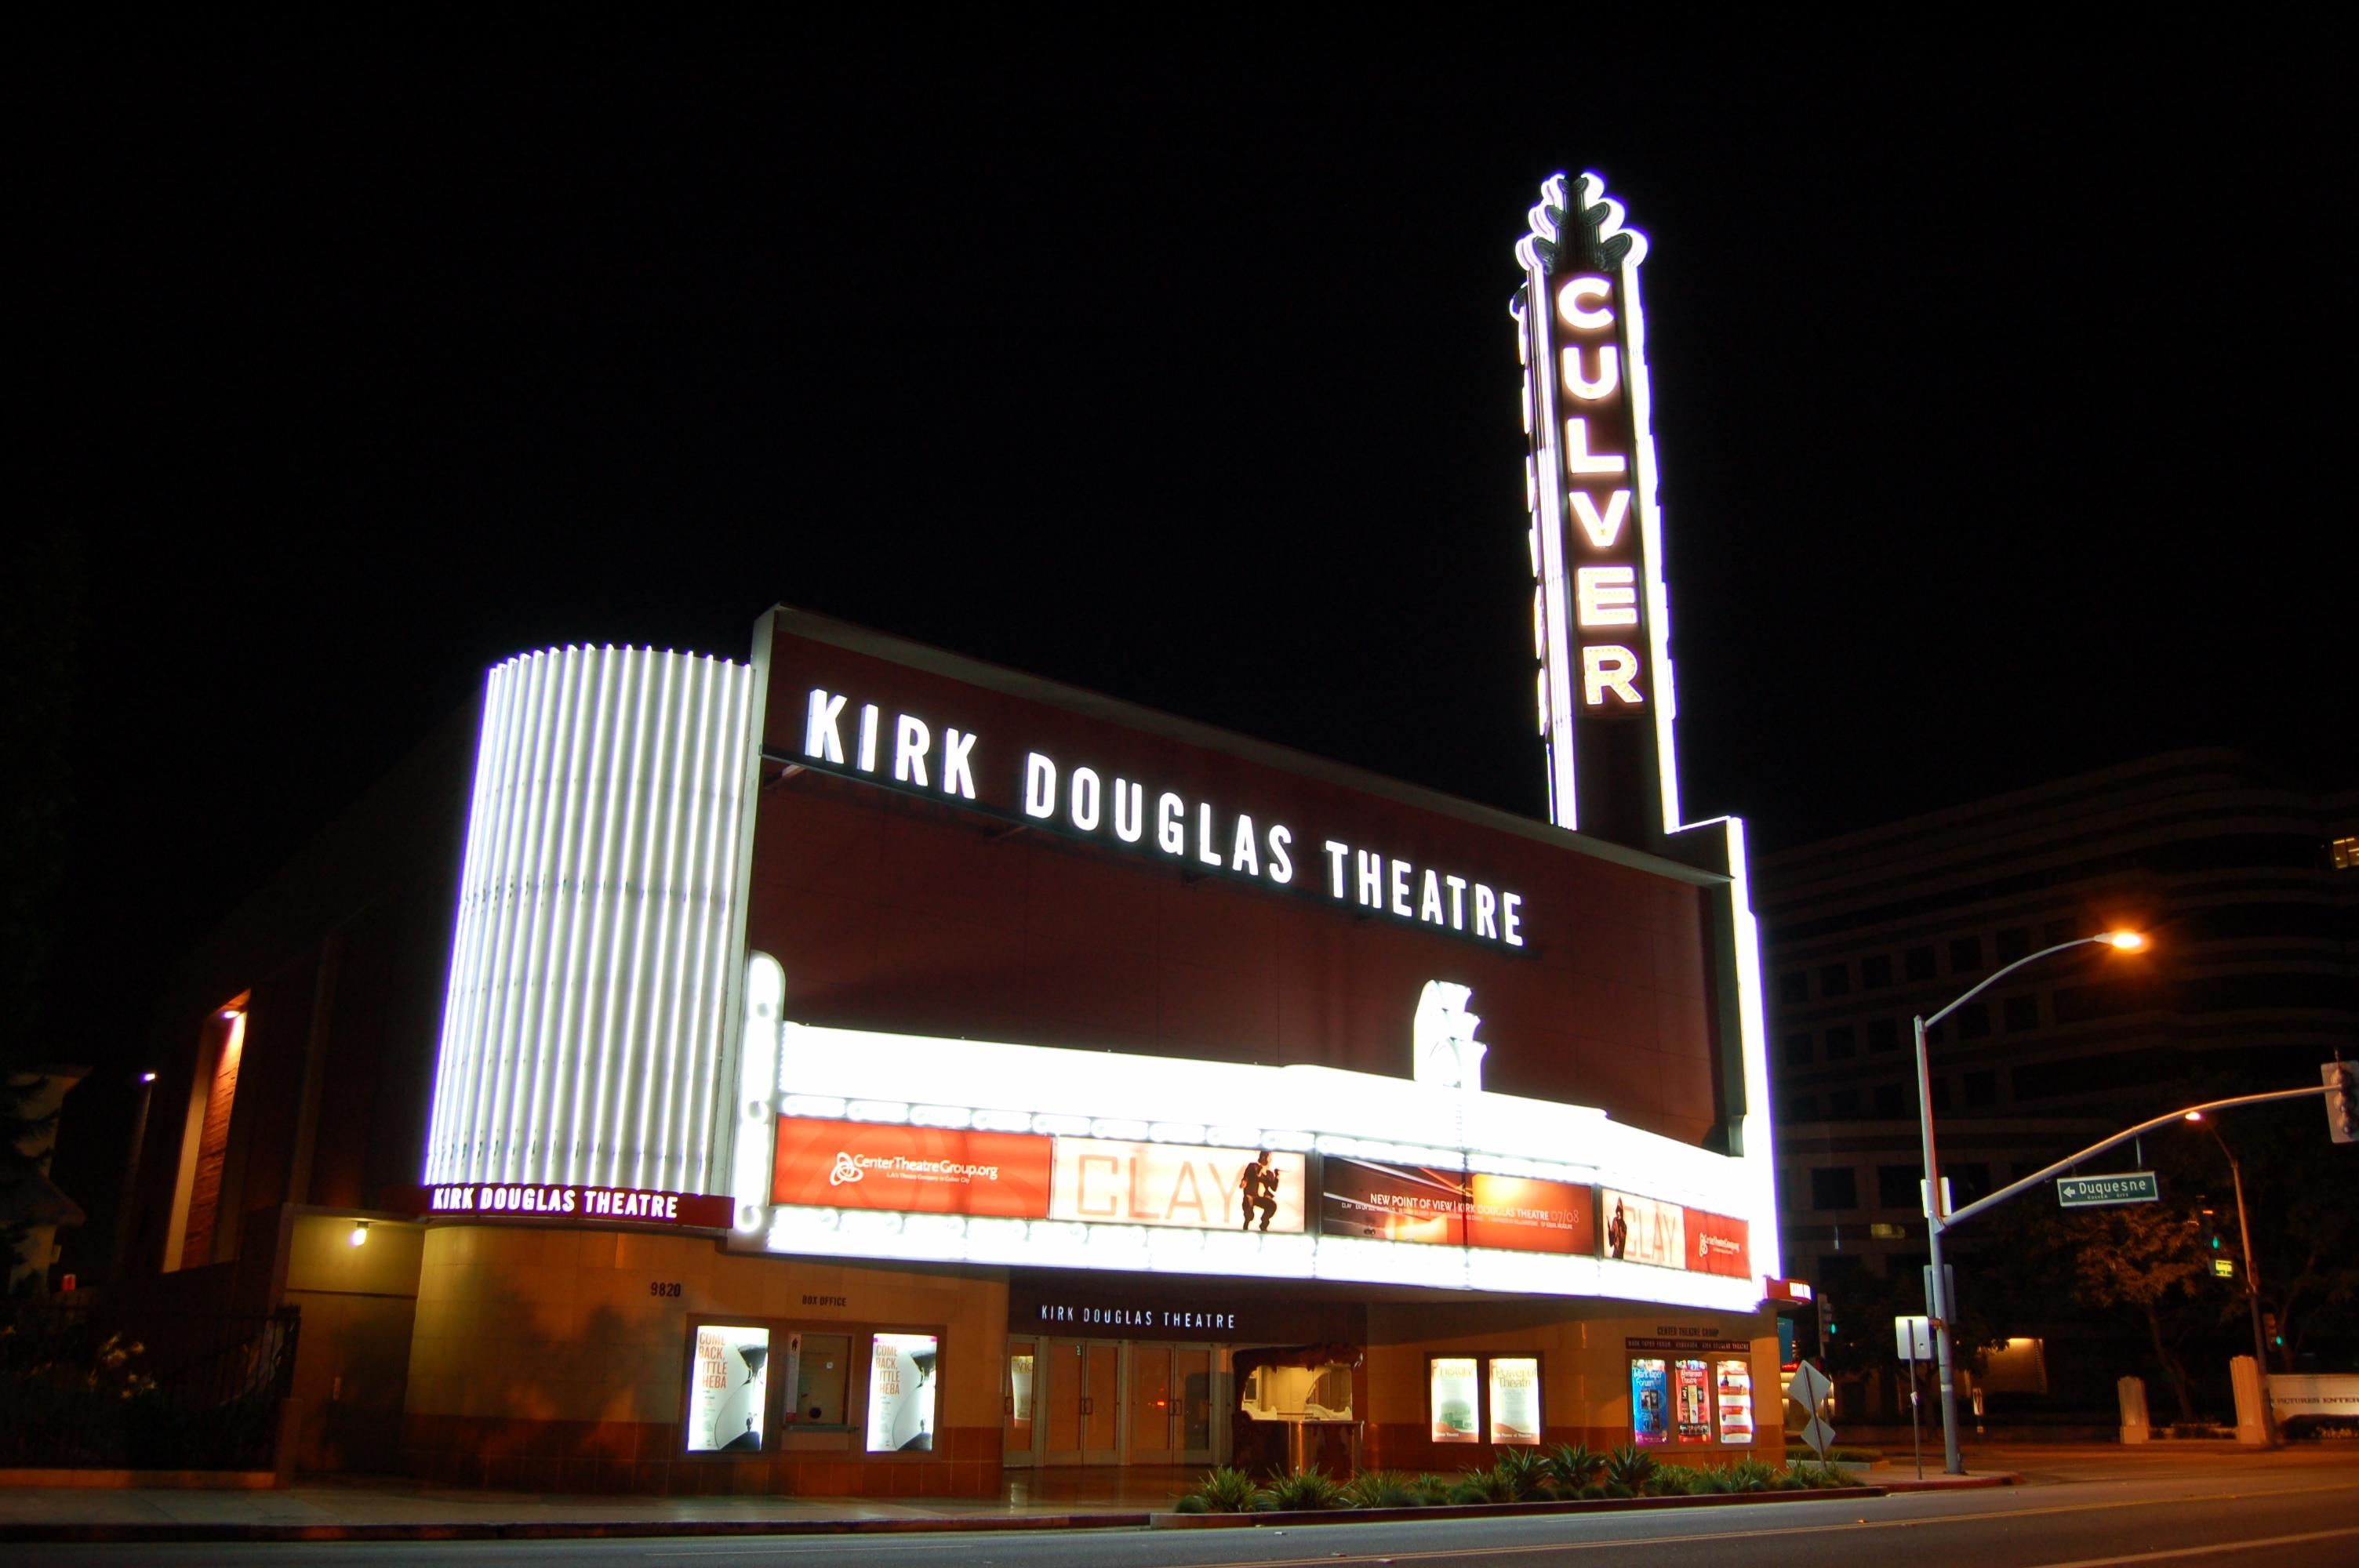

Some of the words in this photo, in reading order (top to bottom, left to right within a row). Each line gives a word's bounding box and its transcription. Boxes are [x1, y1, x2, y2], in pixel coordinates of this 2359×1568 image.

[1558, 277, 1644, 706] CULVER
[804, 688, 978, 800] KIRK
[1023, 751, 1294, 884] DOUGLAS
[1325, 839, 1524, 947] THEATRE
[1078, 1153, 1245, 1223] CLAY
[2078, 1180, 2146, 1194] Duquesne
[433, 1187, 474, 1210] KIRK
[479, 1187, 576, 1212] DOUGLAS
[583, 1190, 679, 1219] THEATRE
[1370, 1193, 1390, 1206] NEW
[1392, 1196, 1418, 1208] POINT
[1419, 1198, 1431, 1209] OF
[1432, 1200, 1453, 1212] VIEW
[1458, 1202, 1475, 1214] KIRK
[1478, 1205, 1515, 1217] DOUGLAS
[1518, 1208, 1549, 1221] THEATRE
[1550, 1208, 1579, 1224] 07/08
[1623, 1205, 1677, 1262] CLAY
[650, 1281, 682, 1298] 9820
[802, 1294, 817, 1305] BOX
[820, 1296, 847, 1307] OFFICE
[1041, 1305, 1074, 1321] KIRK
[1083, 1308, 1153, 1326] DOUGLAS
[1163, 1312, 1235, 1329] THEATRE
[700, 1332, 725, 1345] COME
[699, 1345, 725, 1361] BACK,
[876, 1344, 898, 1357] COME
[702, 1361, 728, 1375] ITTLE
[876, 1357, 898, 1370] BACK,
[702, 1375, 727, 1389] HEBA
[879, 1370, 900, 1383] ITTLE
[879, 1382, 900, 1395] HEBA
